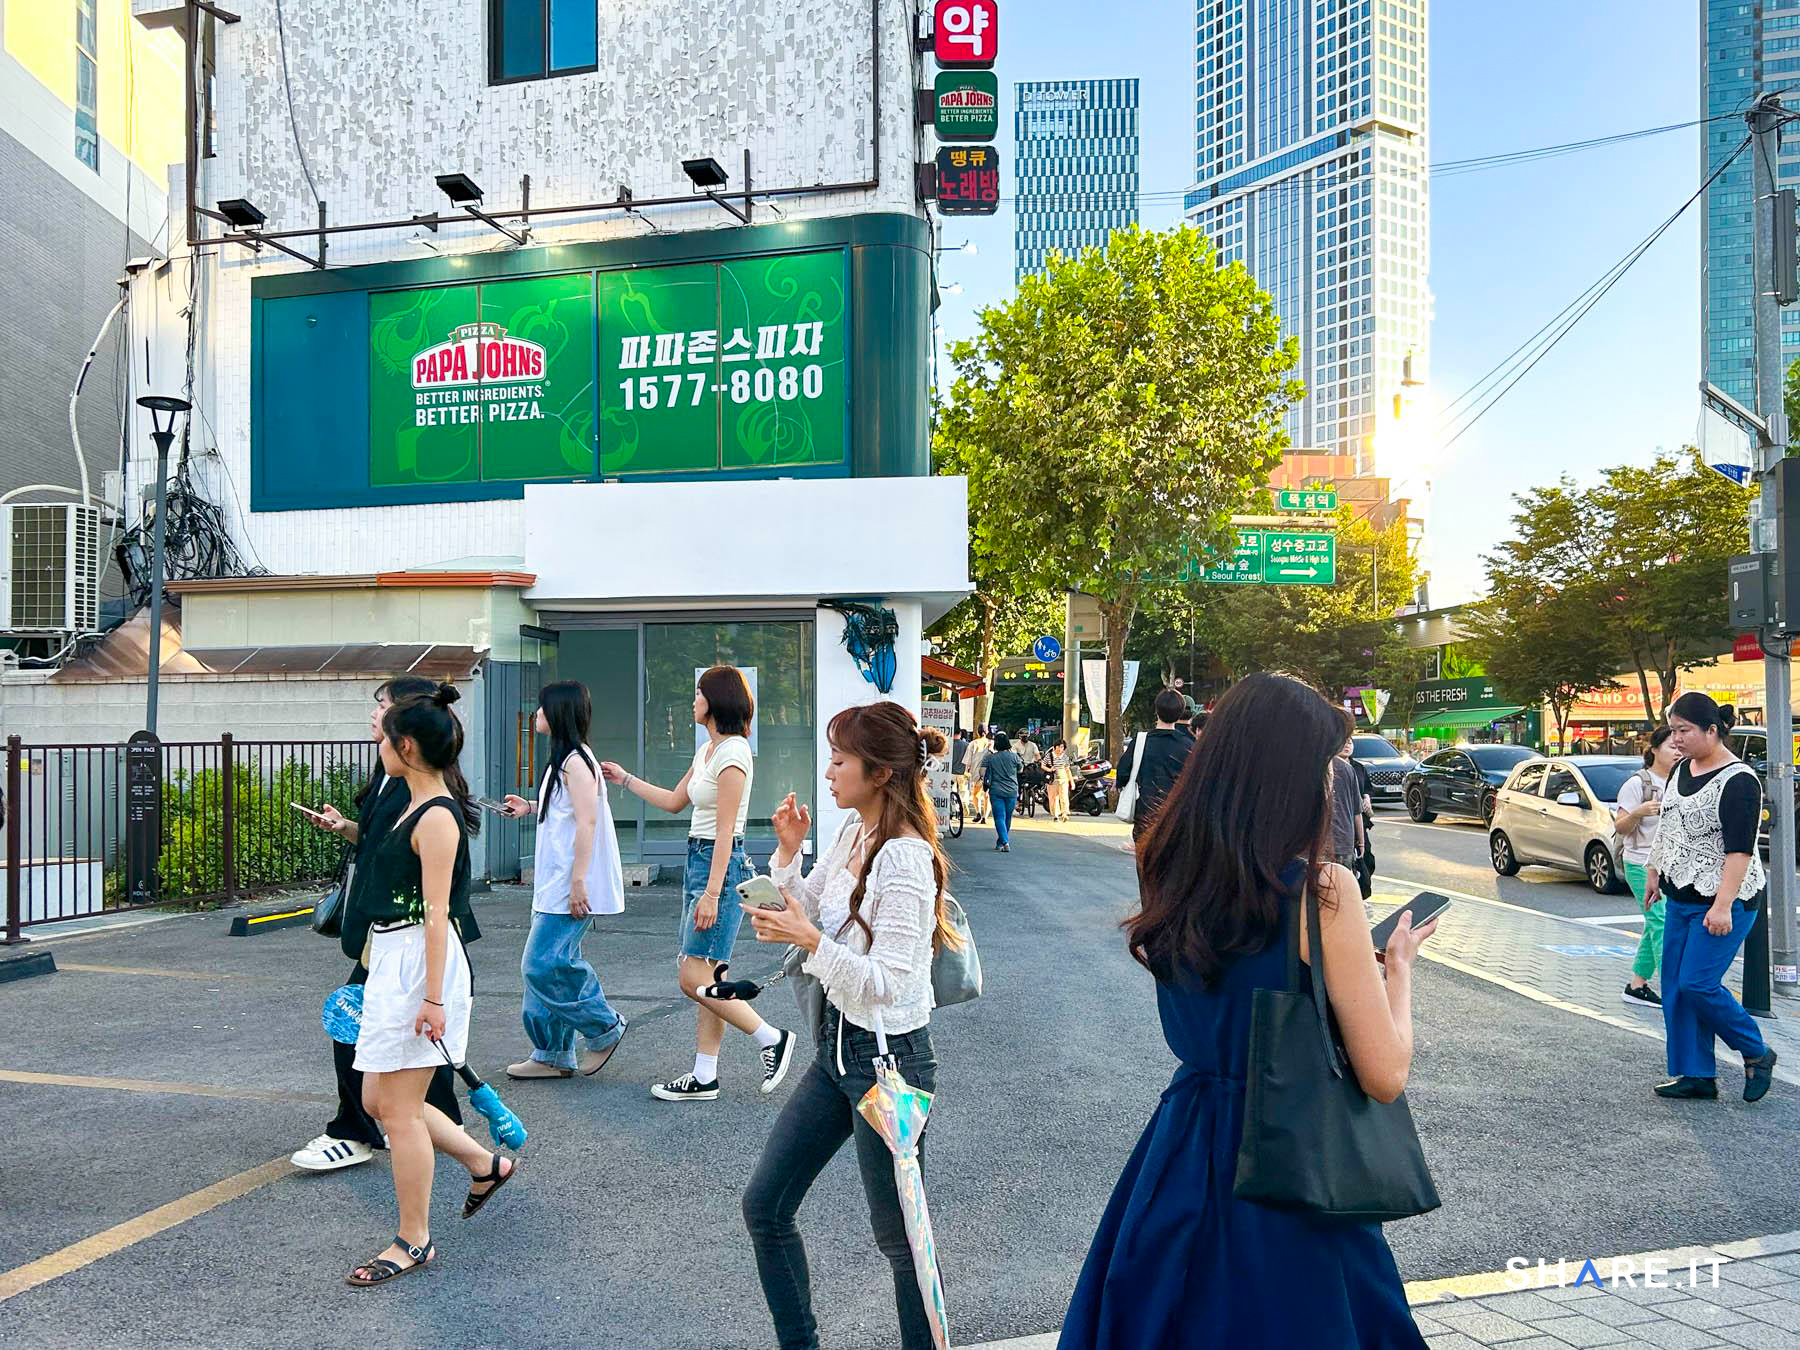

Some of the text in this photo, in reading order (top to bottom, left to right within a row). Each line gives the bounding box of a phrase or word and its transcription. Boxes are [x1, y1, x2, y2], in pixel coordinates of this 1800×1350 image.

[943, 4, 989, 56] 약
[940, 93, 963, 106] PAPA
[950, 150, 987, 167] 땡큐
[938, 169, 999, 202] 노래방
[460, 326, 495, 338] PIZZA
[618, 321, 824, 370] 파파존스피자
[416, 345, 469, 384] PAPA
[416, 384, 546, 406] BETTER INGREDIENTS.
[619, 364, 824, 411] 1577-8080
[415, 400, 546, 427] BETTER PIZZA.
[1211, 570, 1260, 581] Seoul Forest
[1415, 691, 1425, 704] GS
[1426, 689, 1441, 703] THE
[1441, 687, 1468, 703] FRESH
